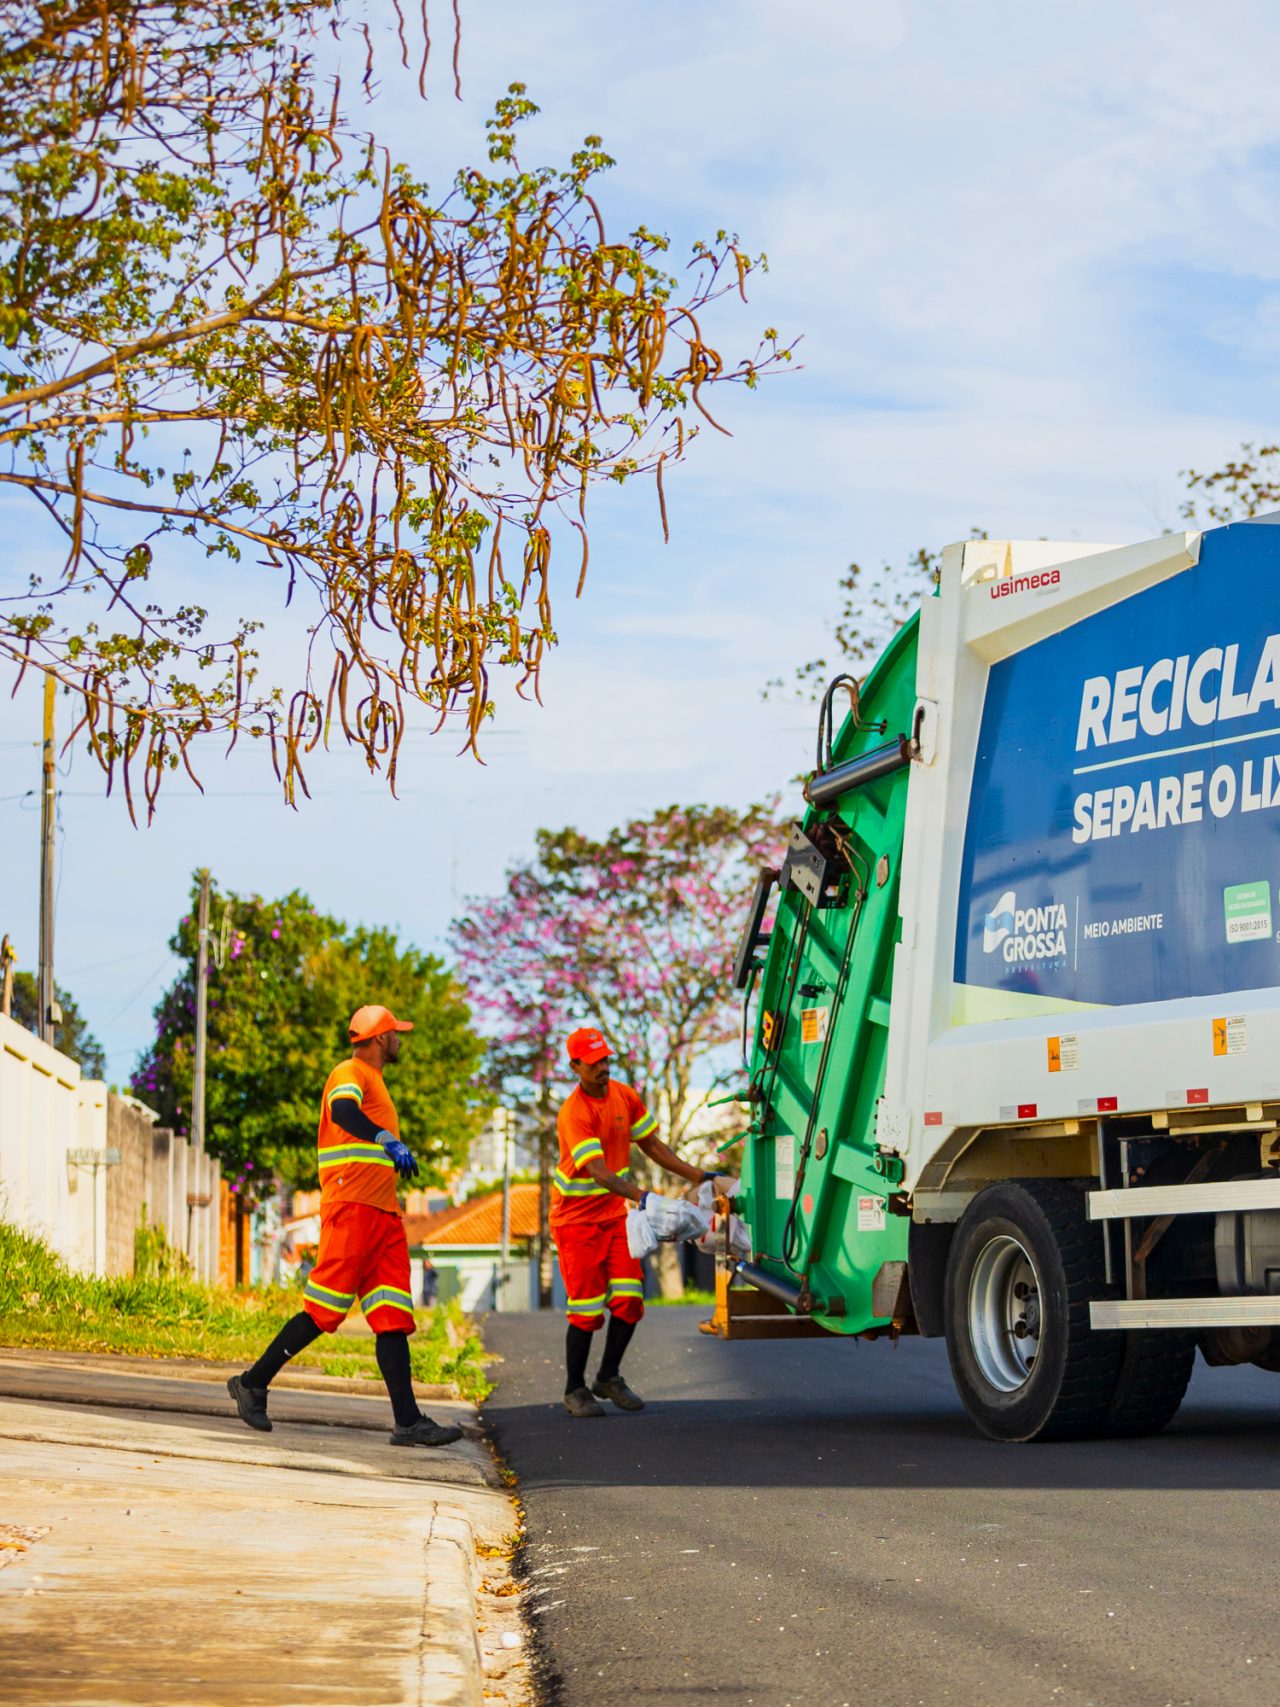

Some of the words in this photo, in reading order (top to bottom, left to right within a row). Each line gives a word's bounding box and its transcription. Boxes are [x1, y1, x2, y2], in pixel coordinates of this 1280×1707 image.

[990, 569, 1061, 599] usimeca
[1072, 769, 1204, 844] SEPARE
[1208, 764, 1237, 818] O
[1014, 903, 1068, 935] PONTA
[1084, 921, 1109, 939] MEIO
[1111, 913, 1163, 936] AMBIENTE
[1229, 923, 1239, 934] ISO
[1239, 919, 1268, 932] 9001:2015
[1003, 930, 1067, 962] GROSSA
